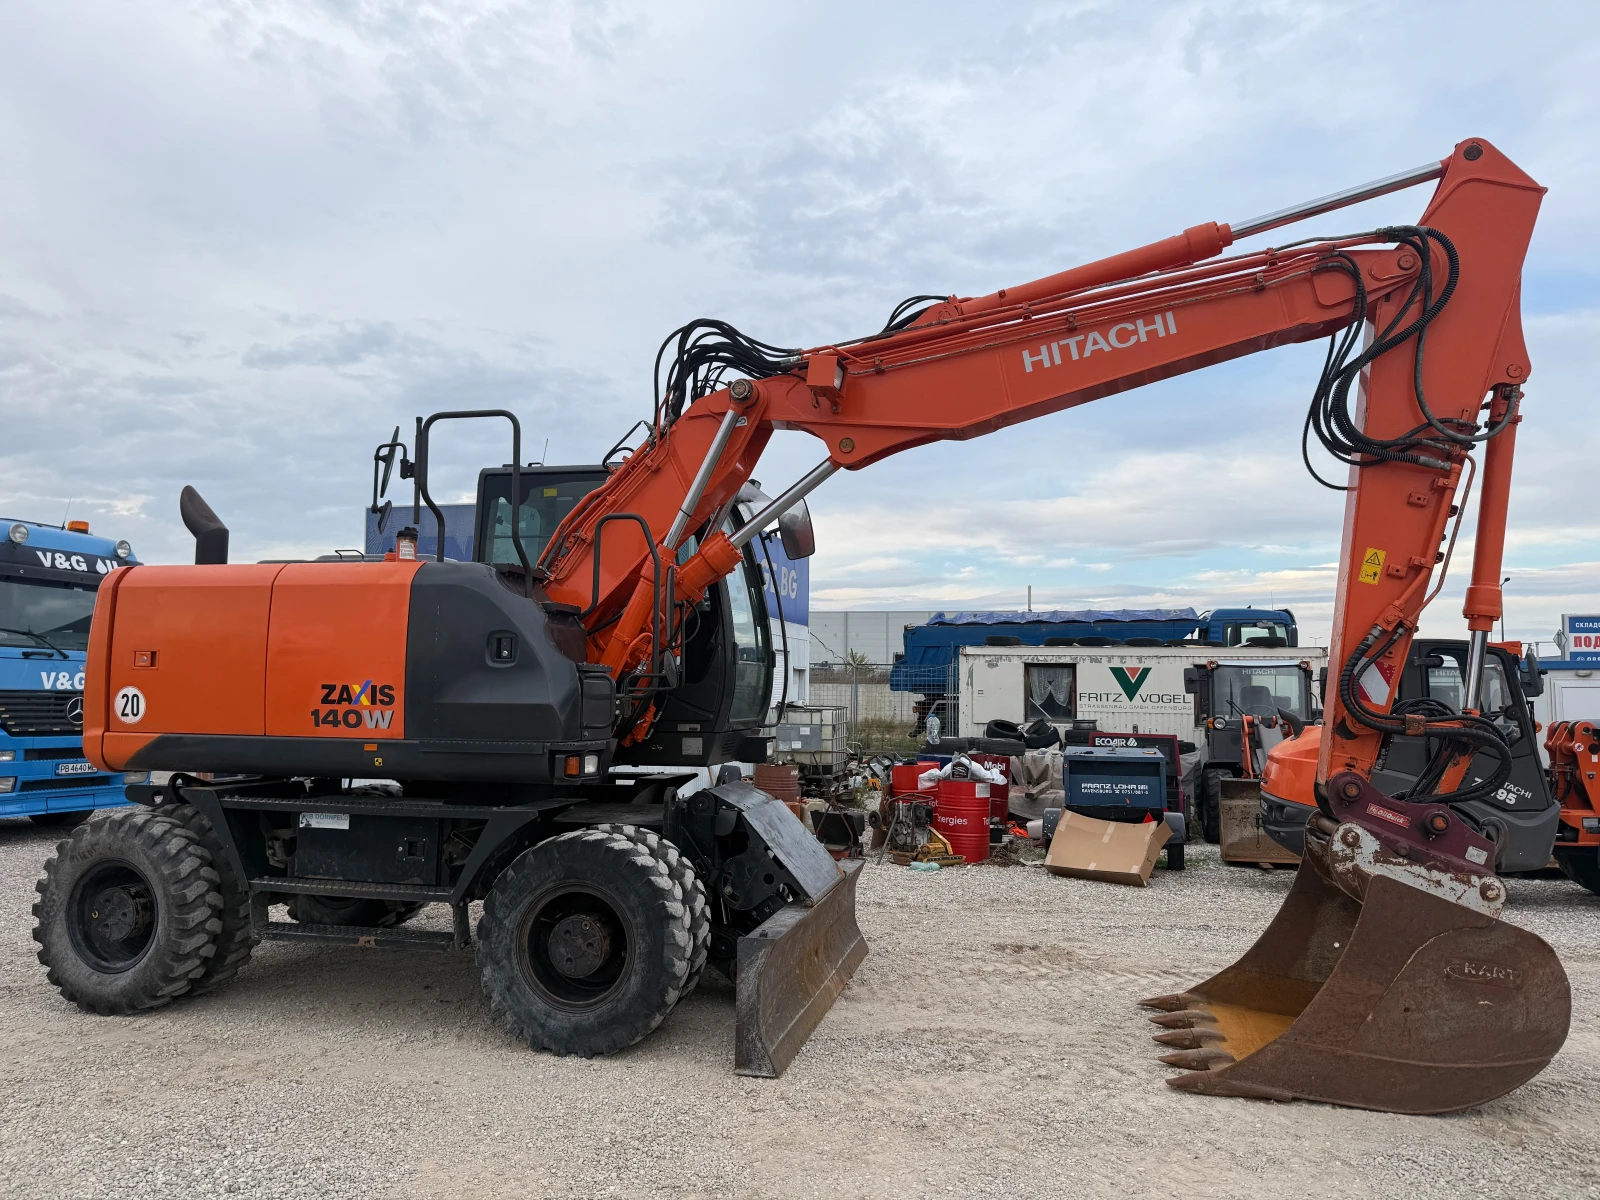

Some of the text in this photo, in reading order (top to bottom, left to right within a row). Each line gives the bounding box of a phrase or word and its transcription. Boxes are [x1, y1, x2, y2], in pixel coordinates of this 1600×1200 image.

[1022, 311, 1177, 373] HITACHI
[36, 551, 88, 571] V&G
[320, 680, 396, 706] ZAXIS
[1079, 692, 1192, 704] FRITZ VOGEL
[121, 693, 140, 717] 20
[310, 709, 394, 729] 140W
[1095, 737, 1126, 747] ECOAIR
[984, 760, 1006, 771] Mobil
